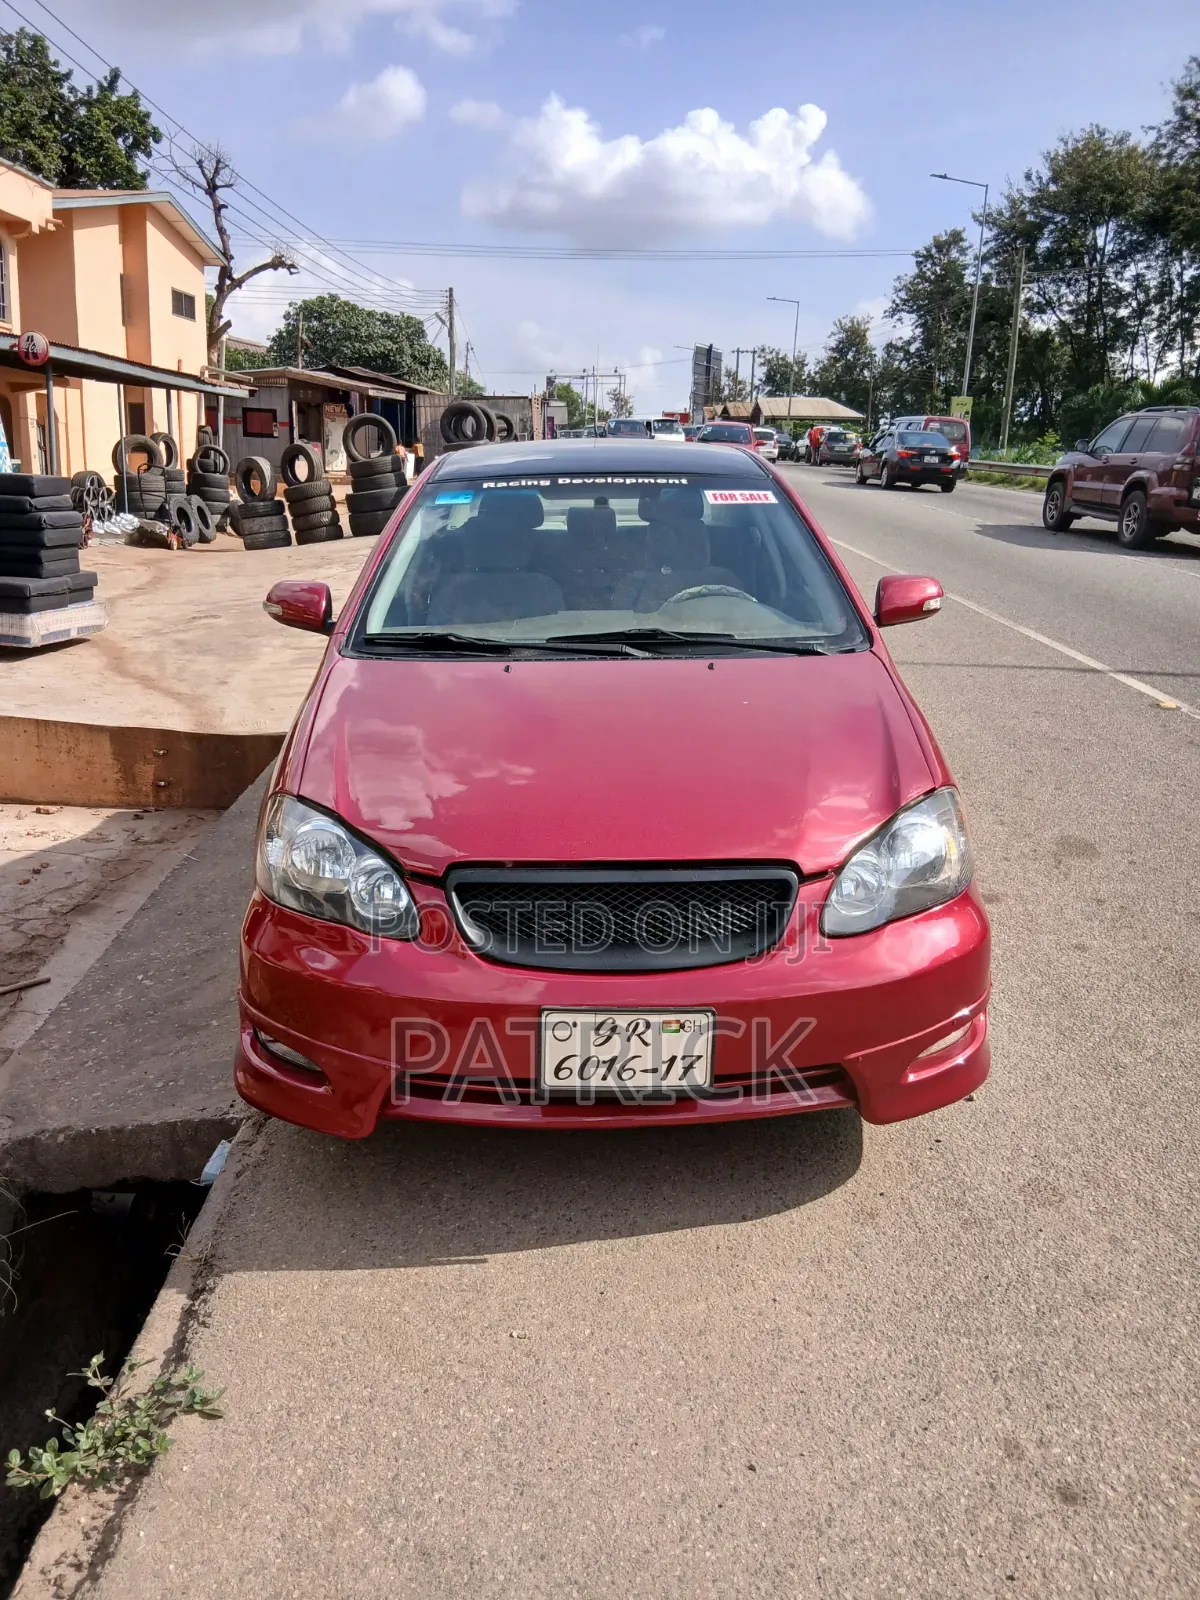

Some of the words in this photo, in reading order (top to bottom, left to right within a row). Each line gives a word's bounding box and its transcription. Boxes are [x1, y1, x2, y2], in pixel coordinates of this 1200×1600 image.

[324, 405, 341, 413] NEW
[482, 479, 551, 489] Racing
[557, 476, 689, 487] Development
[712, 492, 738, 502] FOR
[739, 492, 771, 502] SALE
[592, 1016, 652, 1047] GR
[682, 1018, 703, 1034] GH
[553, 1053, 704, 1082] 6016-17
